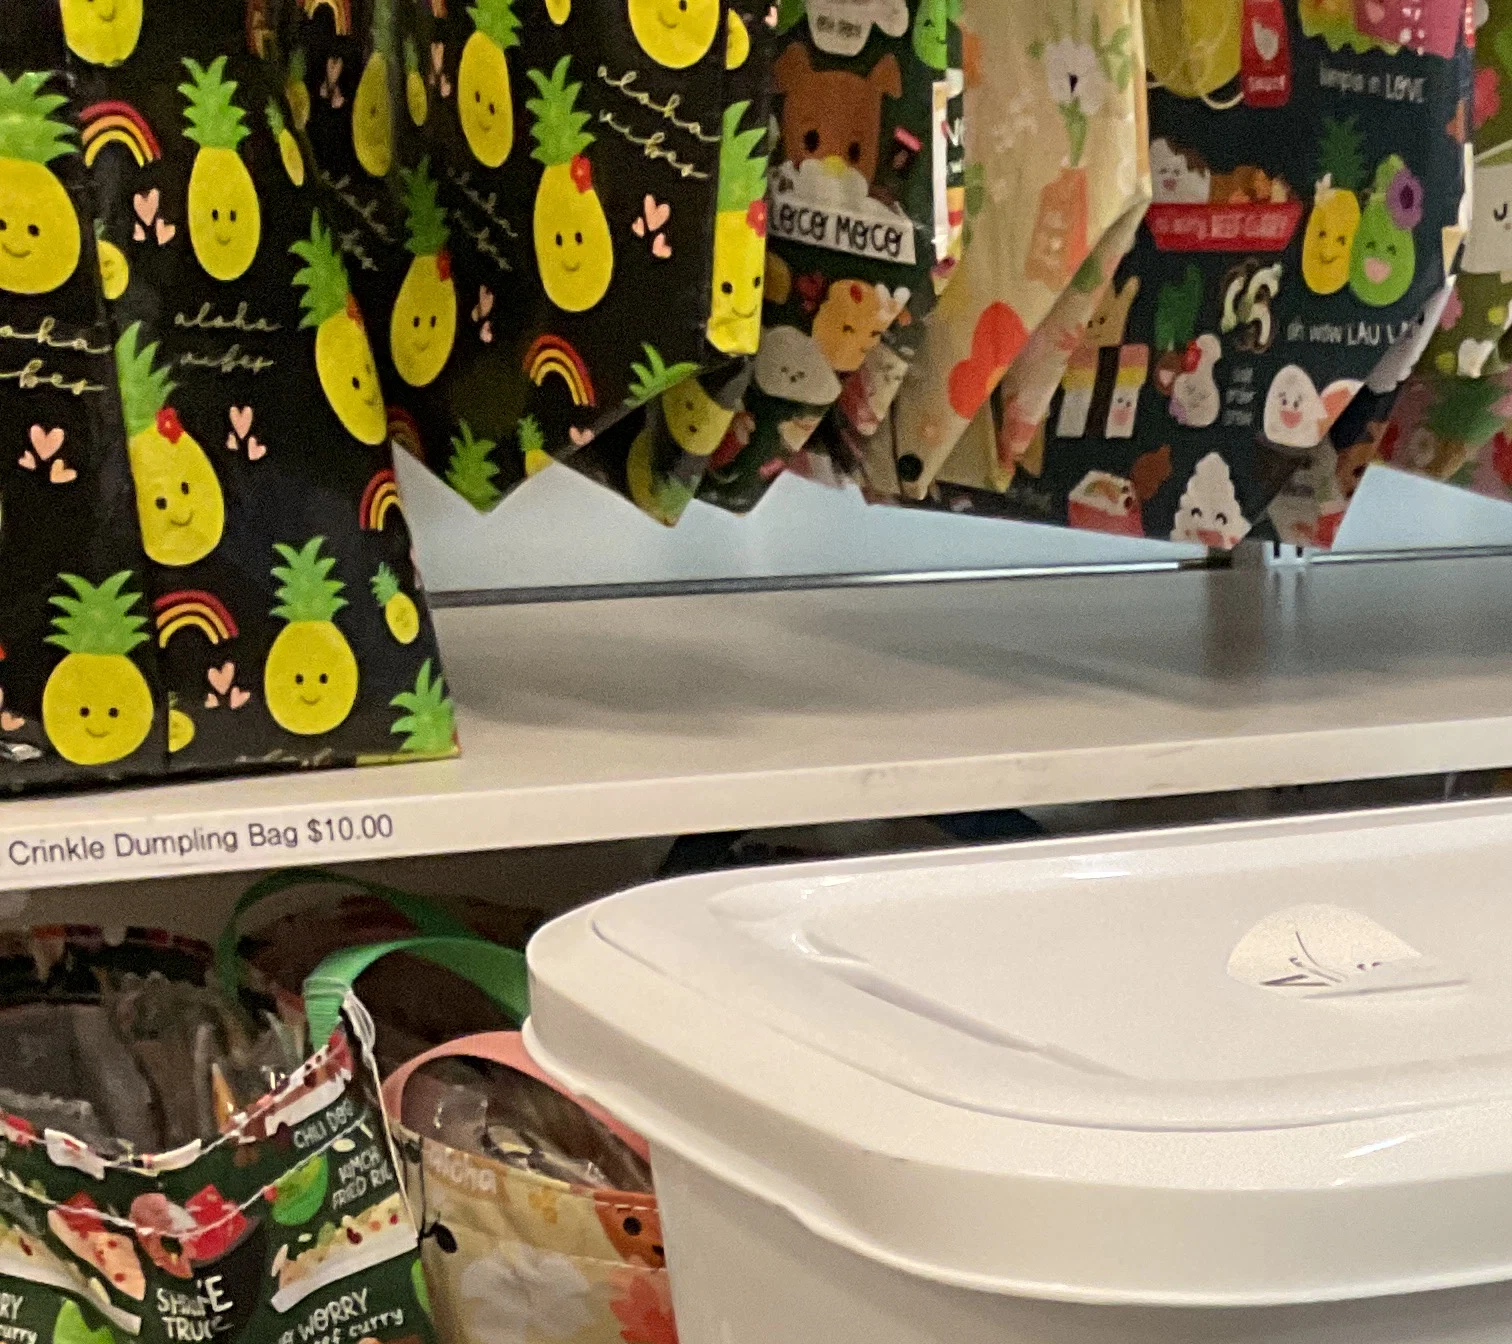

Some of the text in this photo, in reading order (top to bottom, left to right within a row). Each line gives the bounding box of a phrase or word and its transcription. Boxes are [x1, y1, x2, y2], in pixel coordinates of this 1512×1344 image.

[8, 812, 394, 866] Crinkle Dumpling Bag $10.00
[298, 1287, 370, 1340] WORRY
[348, 1307, 404, 1338] curry
